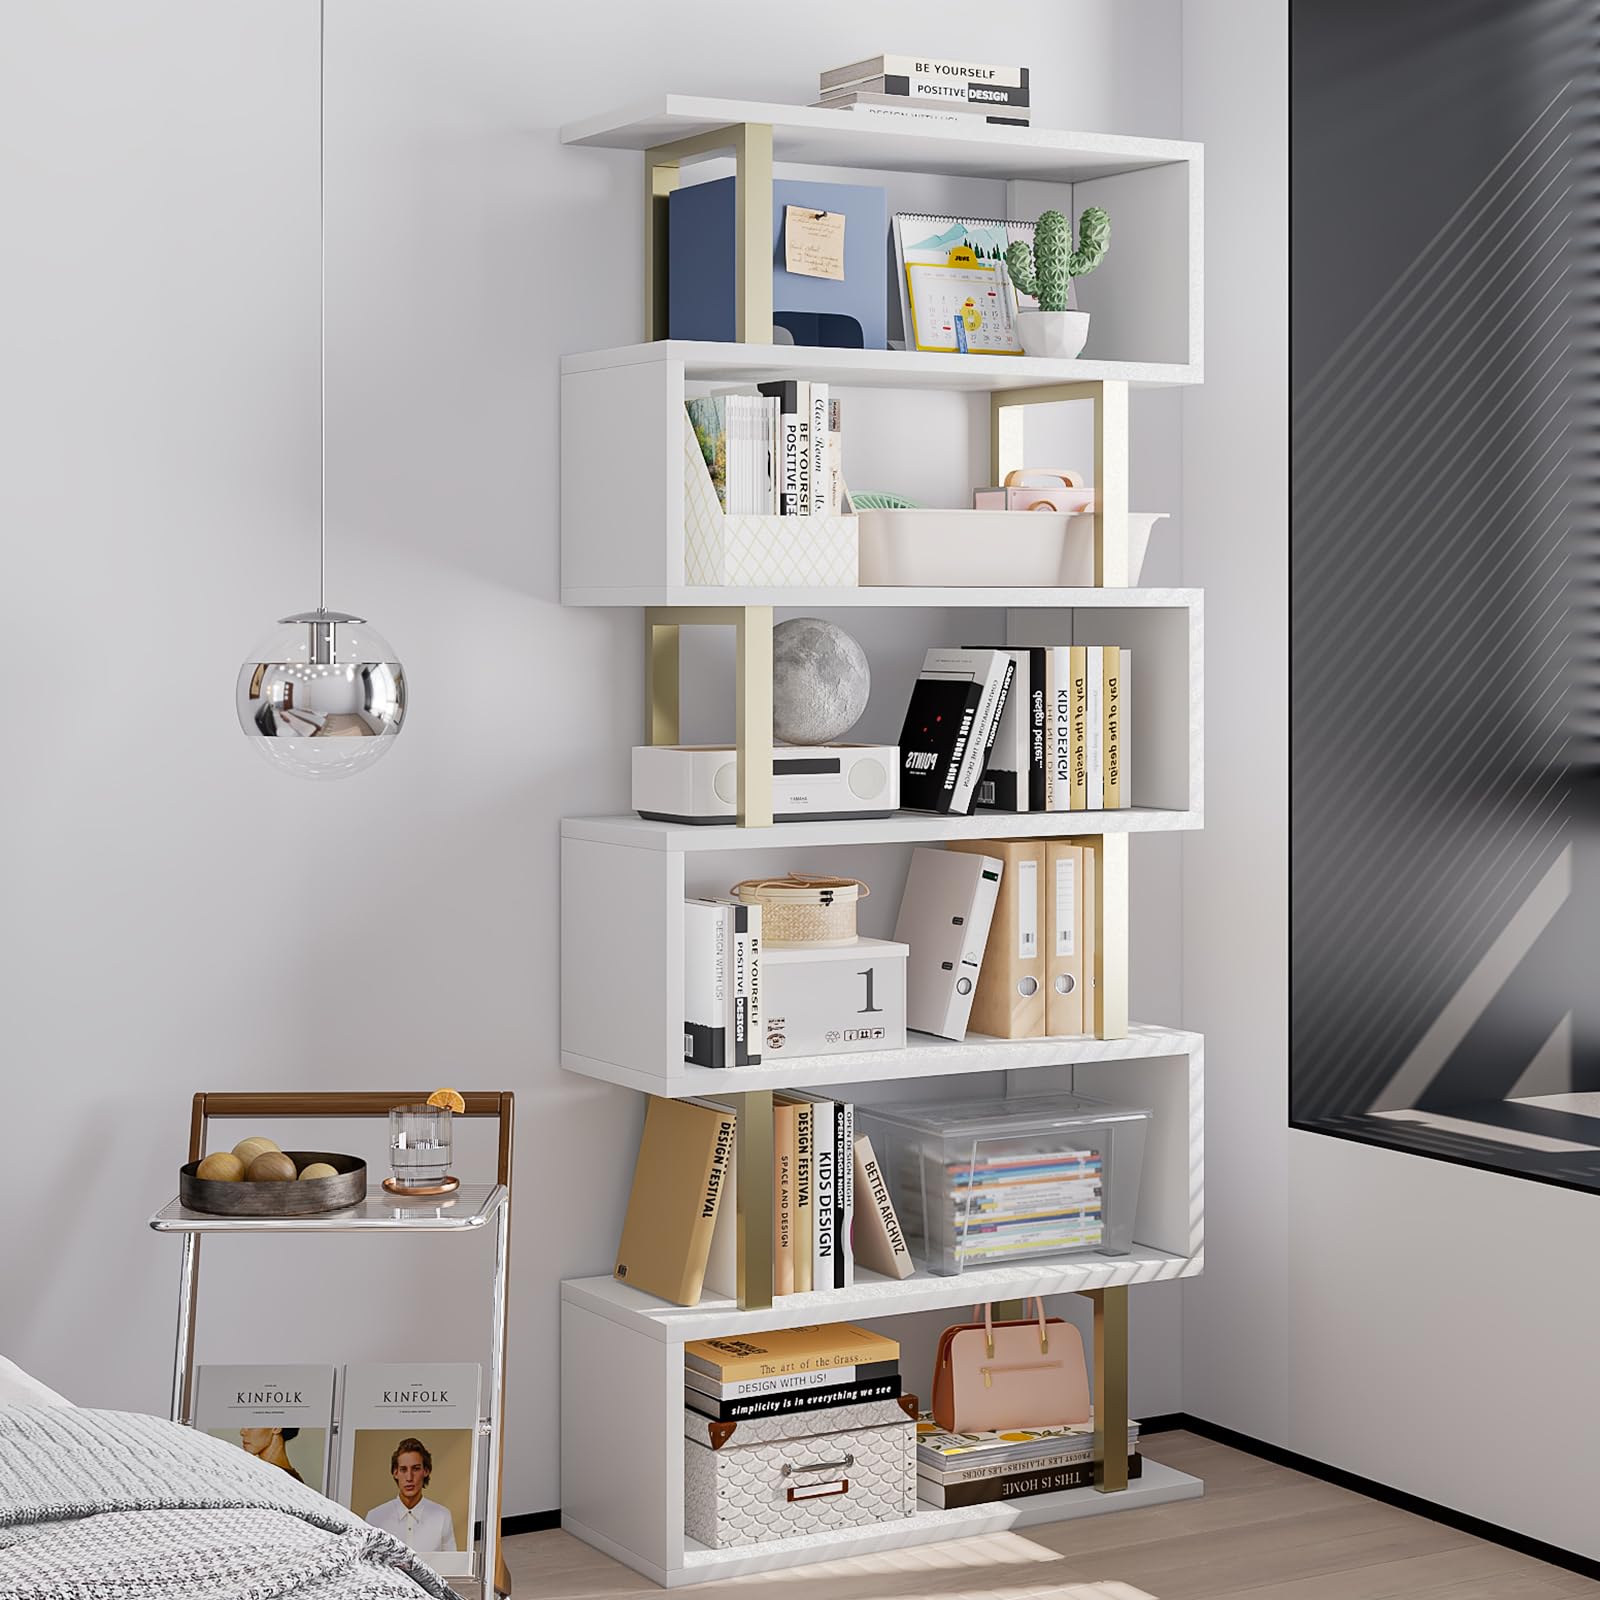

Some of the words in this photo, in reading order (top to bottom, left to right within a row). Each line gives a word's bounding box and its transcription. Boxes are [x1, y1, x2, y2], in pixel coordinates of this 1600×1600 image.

[915, 62, 930, 73] BE
[934, 64, 996, 79] YOURSELF
[917, 84, 966, 98] POSITIVE
[968, 89, 1008, 102] DESIGN
[815, 399, 825, 432] Class
[800, 423, 808, 442] BE
[787, 425, 796, 490] POSITIVE
[815, 436, 825, 472] Room
[751, 939, 758, 954] BE
[857, 967, 883, 1013] 1
[714, 1122, 731, 1164] DESIGN
[798, 1112, 808, 1154] DESIGN
[820, 1152, 832, 1190] KIDS
[702, 1168, 721, 1218] FESTIVAL
[798, 1158, 808, 1208] FESTIVAL
[865, 1161, 888, 1205] BETTER
[881, 1205, 905, 1255] ARCHVIZ
[820, 1195, 832, 1257] DESIGN
[761, 1364, 776, 1375] The
[781, 1361, 794, 1371] art
[800, 1359, 810, 1369] of
[816, 1356, 830, 1367] the
[834, 1354, 872, 1365] Grass...
[738, 1381, 777, 1394] DESIGN
[780, 1376, 806, 1388] WITH
[809, 1374, 827, 1384] US!
[237, 1391, 302, 1403] KINFOLK
[383, 1391, 448, 1403] KINFOLK
[731, 1399, 780, 1415] simplicity
[783, 1398, 792, 1408] is
[795, 1395, 804, 1406] in
[807, 1389, 857, 1405] everything
[876, 1385, 892, 1394] see
[987, 1466, 1002, 1474] LES
[1008, 1459, 1045, 1472] PLAISIRS
[1048, 1456, 1064, 1465] LES
[962, 1468, 985, 1480] JOURS
[1041, 1476, 1052, 1488] IS
[1056, 1471, 1081, 1485] THIS
[1002, 1477, 1038, 1495] HOME
